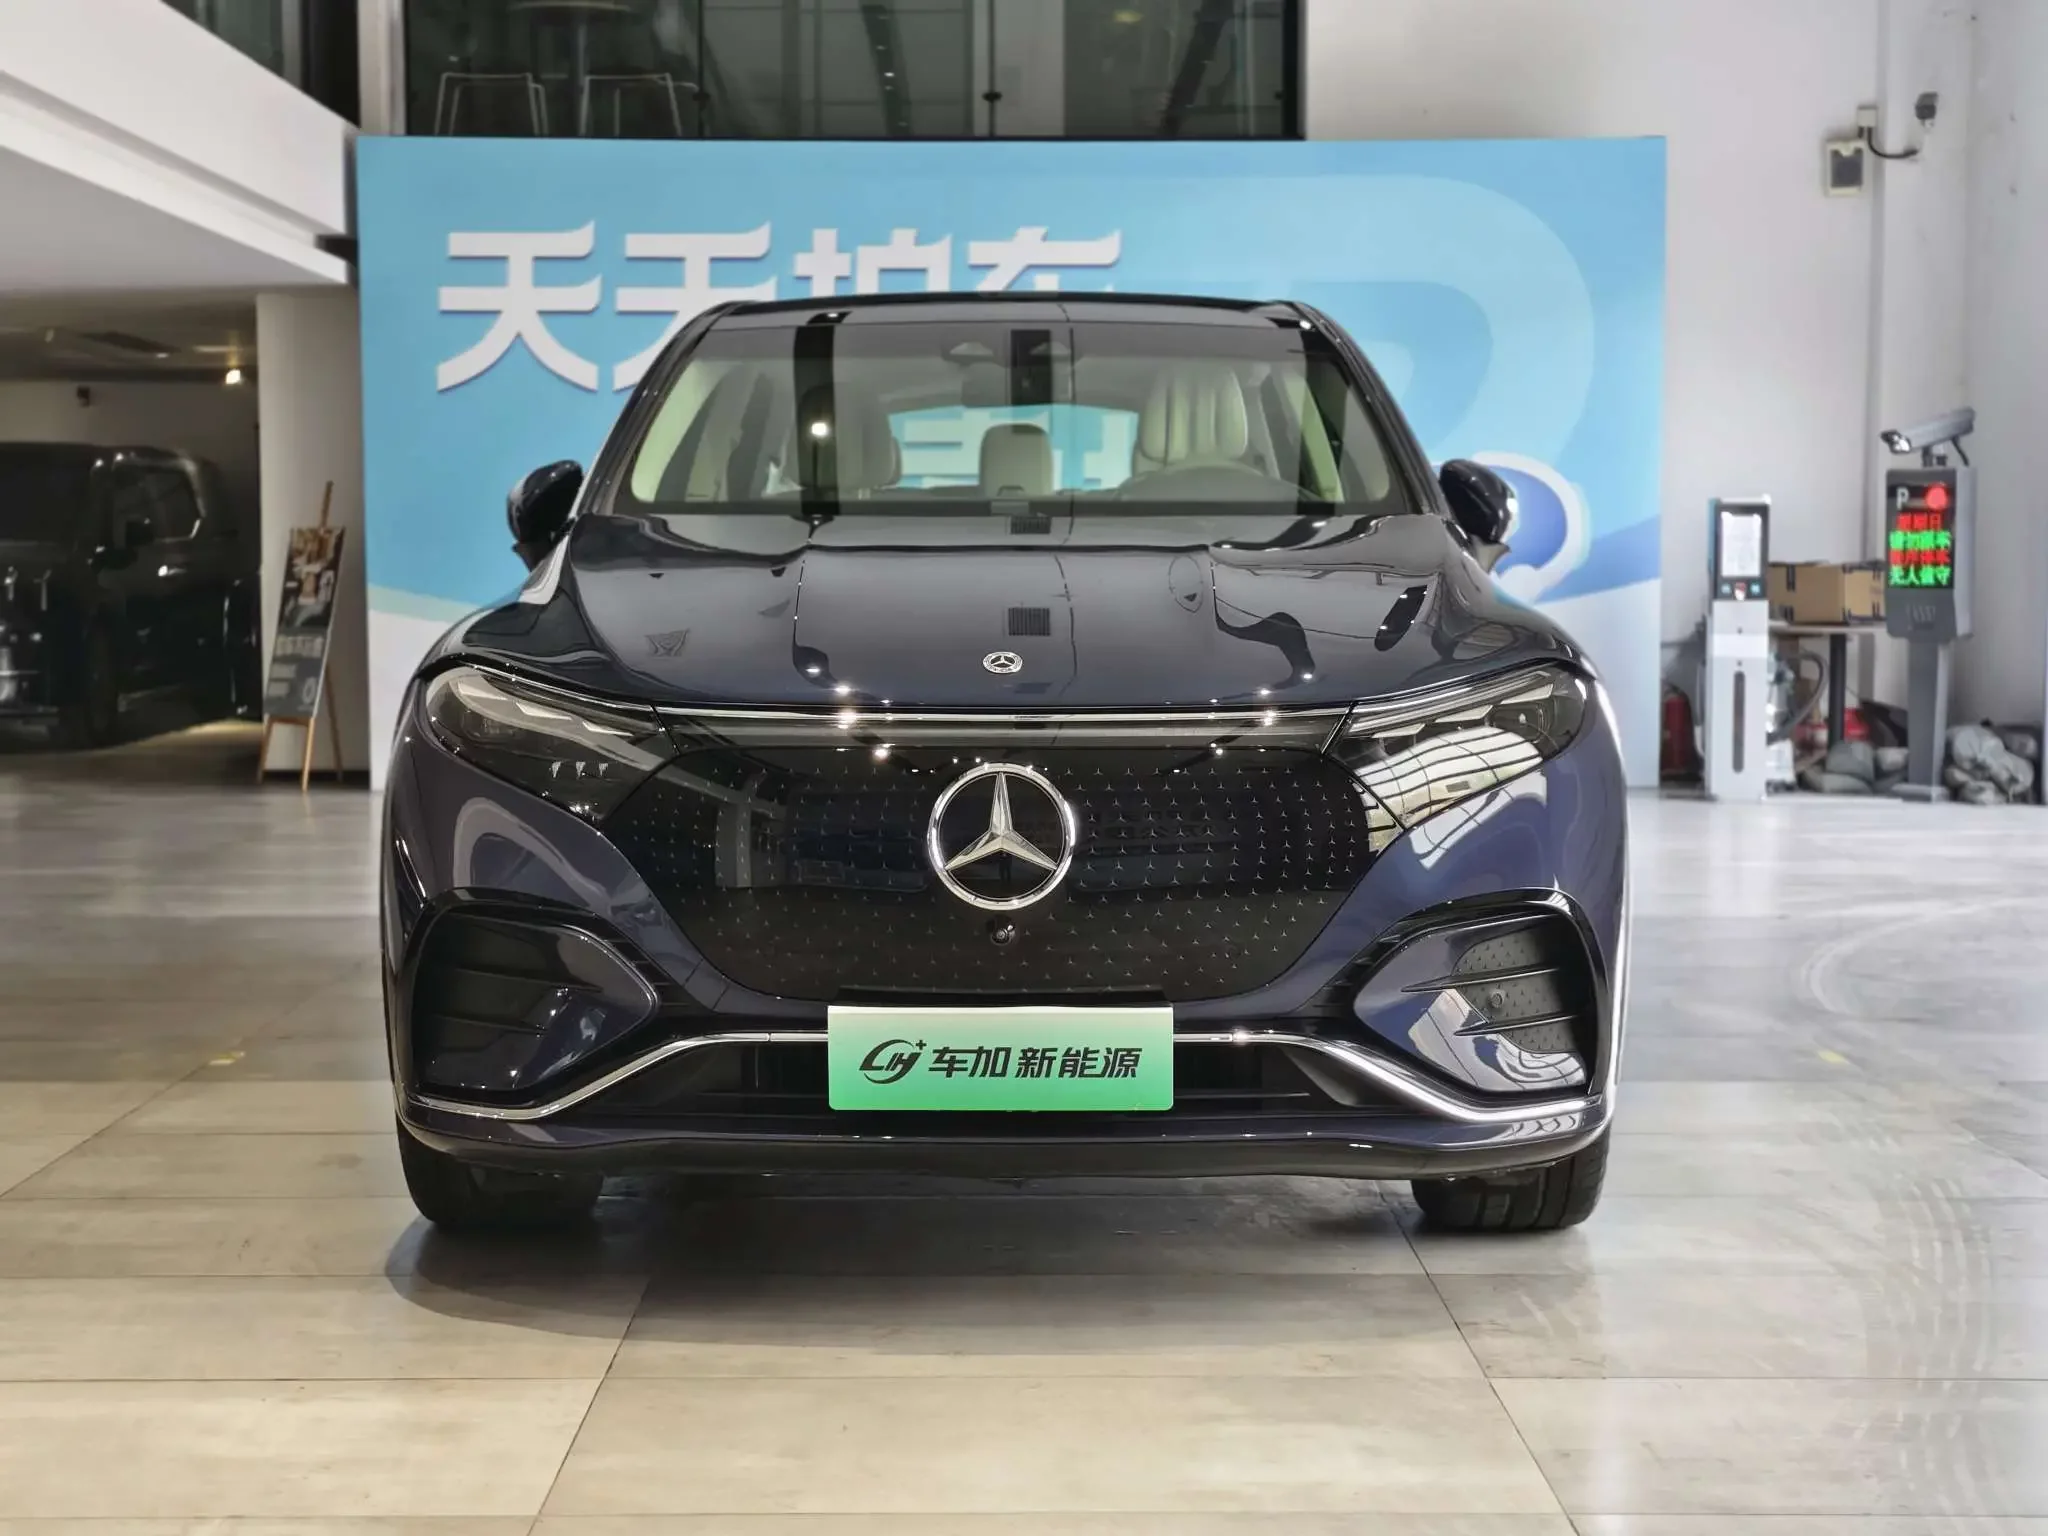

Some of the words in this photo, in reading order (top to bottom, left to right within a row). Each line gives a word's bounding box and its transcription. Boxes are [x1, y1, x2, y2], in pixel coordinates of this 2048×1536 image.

[1897, 486, 1910, 510] P
[928, 1046, 1143, 1079] 车加新能源
